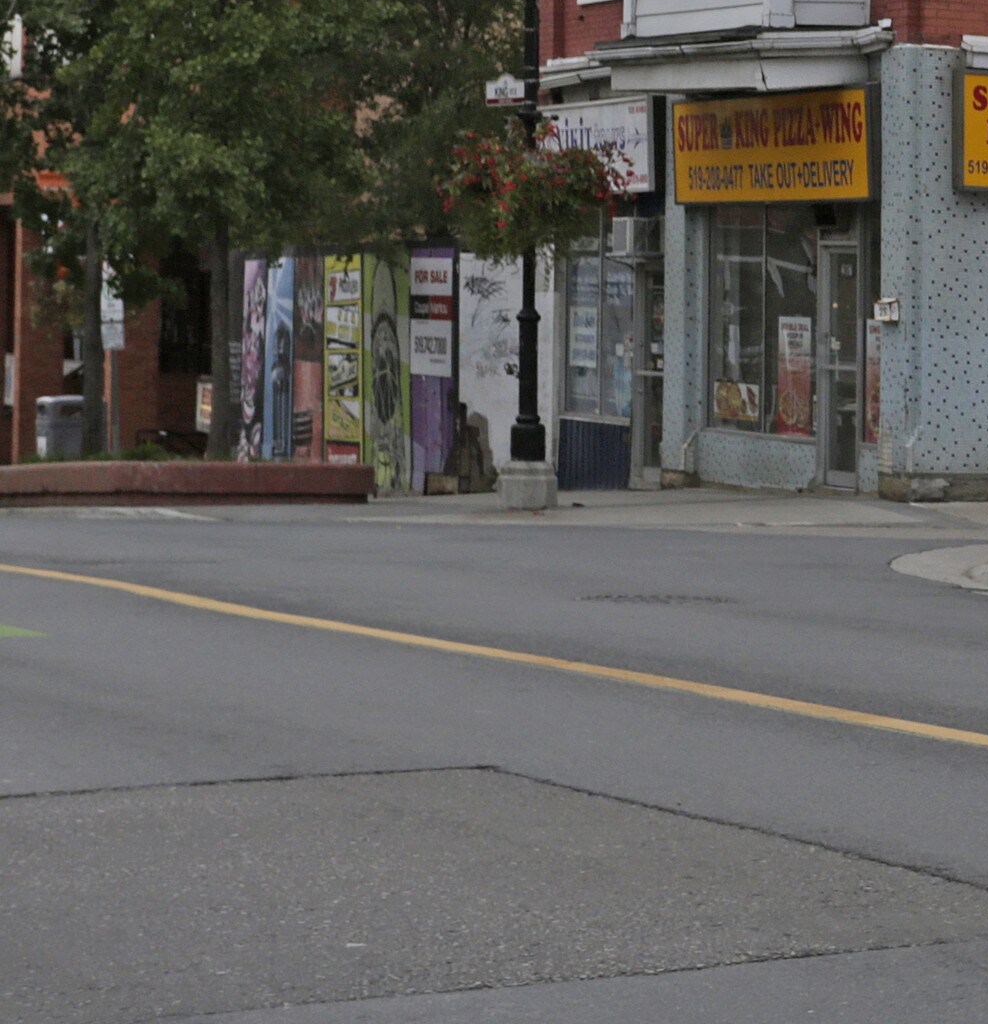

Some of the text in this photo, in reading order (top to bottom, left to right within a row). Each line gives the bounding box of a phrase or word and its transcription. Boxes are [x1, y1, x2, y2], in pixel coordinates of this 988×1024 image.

[678, 113, 719, 152] SUPER
[735, 108, 769, 149] KING
[748, 163, 774, 189] TAKE
[415, 270, 448, 284] FOR SALE
